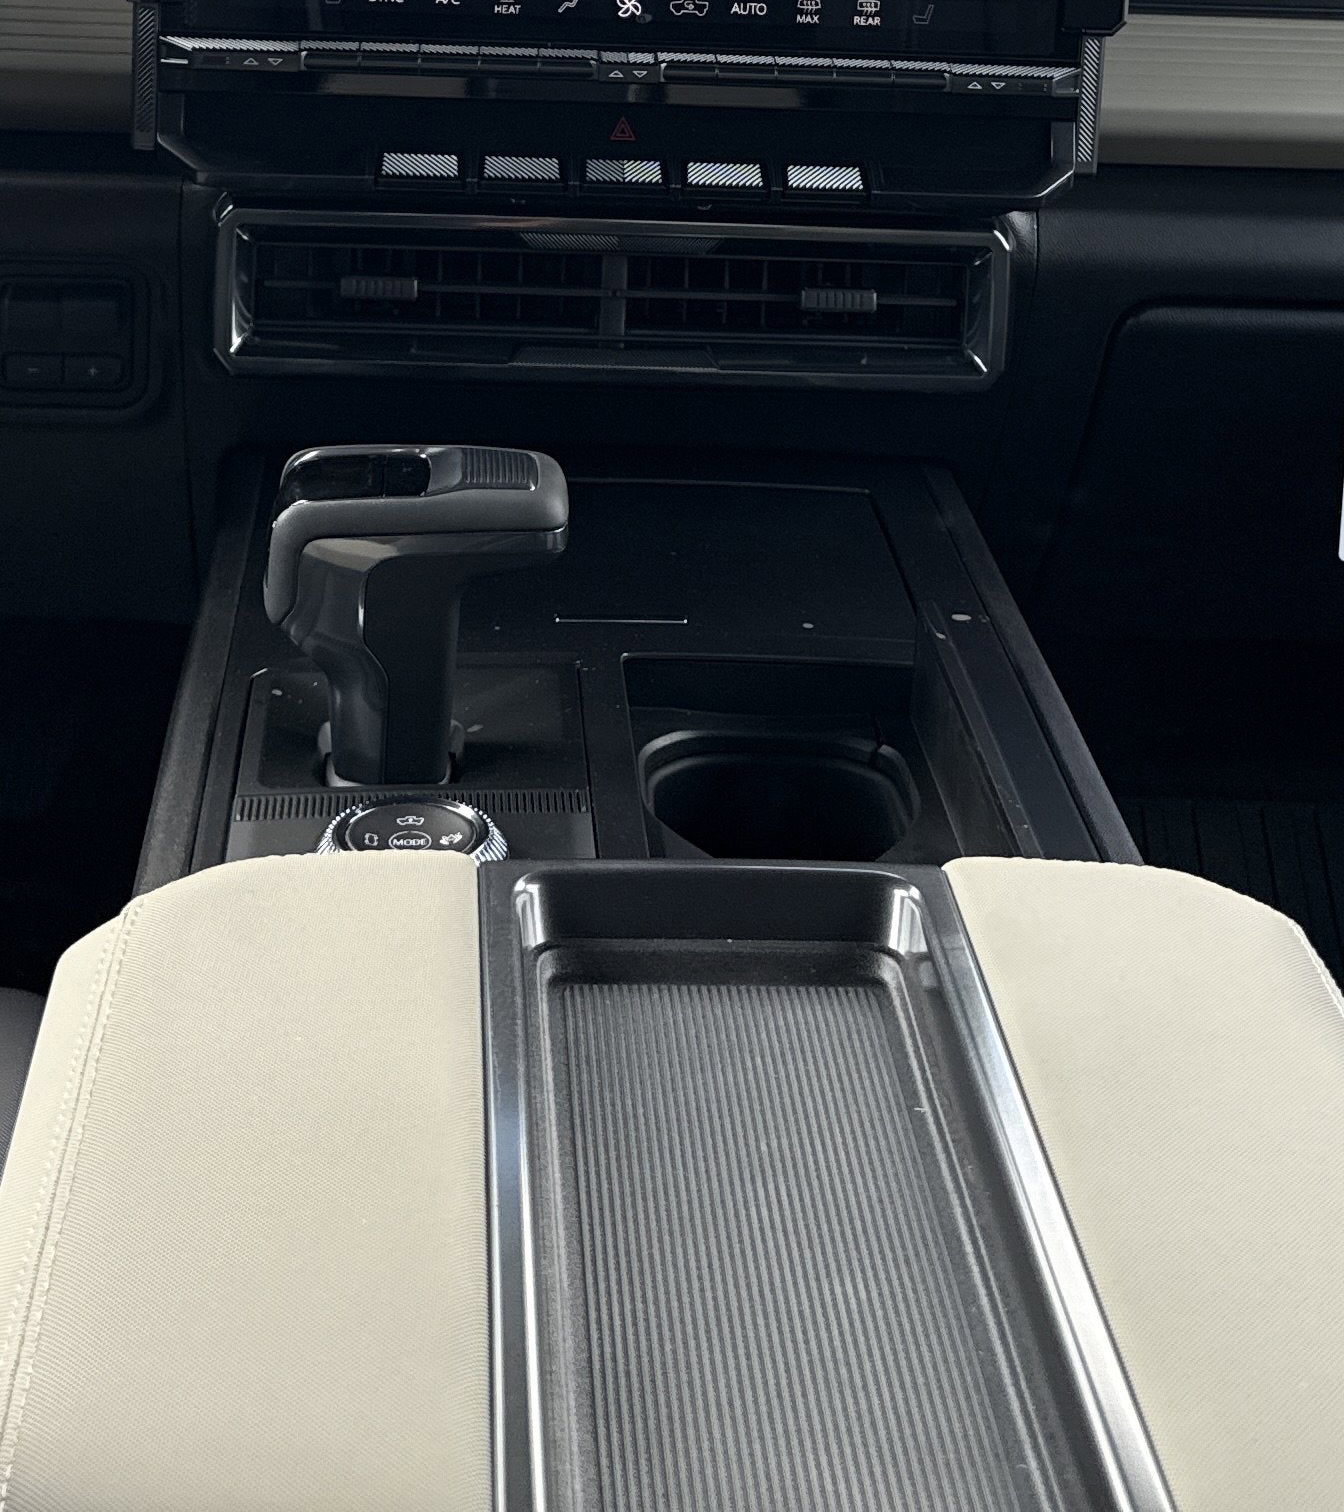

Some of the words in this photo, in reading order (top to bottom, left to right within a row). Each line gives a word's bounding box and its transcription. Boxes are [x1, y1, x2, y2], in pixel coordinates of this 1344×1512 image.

[494, 5, 521, 15] HEAT
[730, 1, 767, 16] AUTO
[796, 14, 820, 25] MAX
[853, 15, 881, 26] REAR
